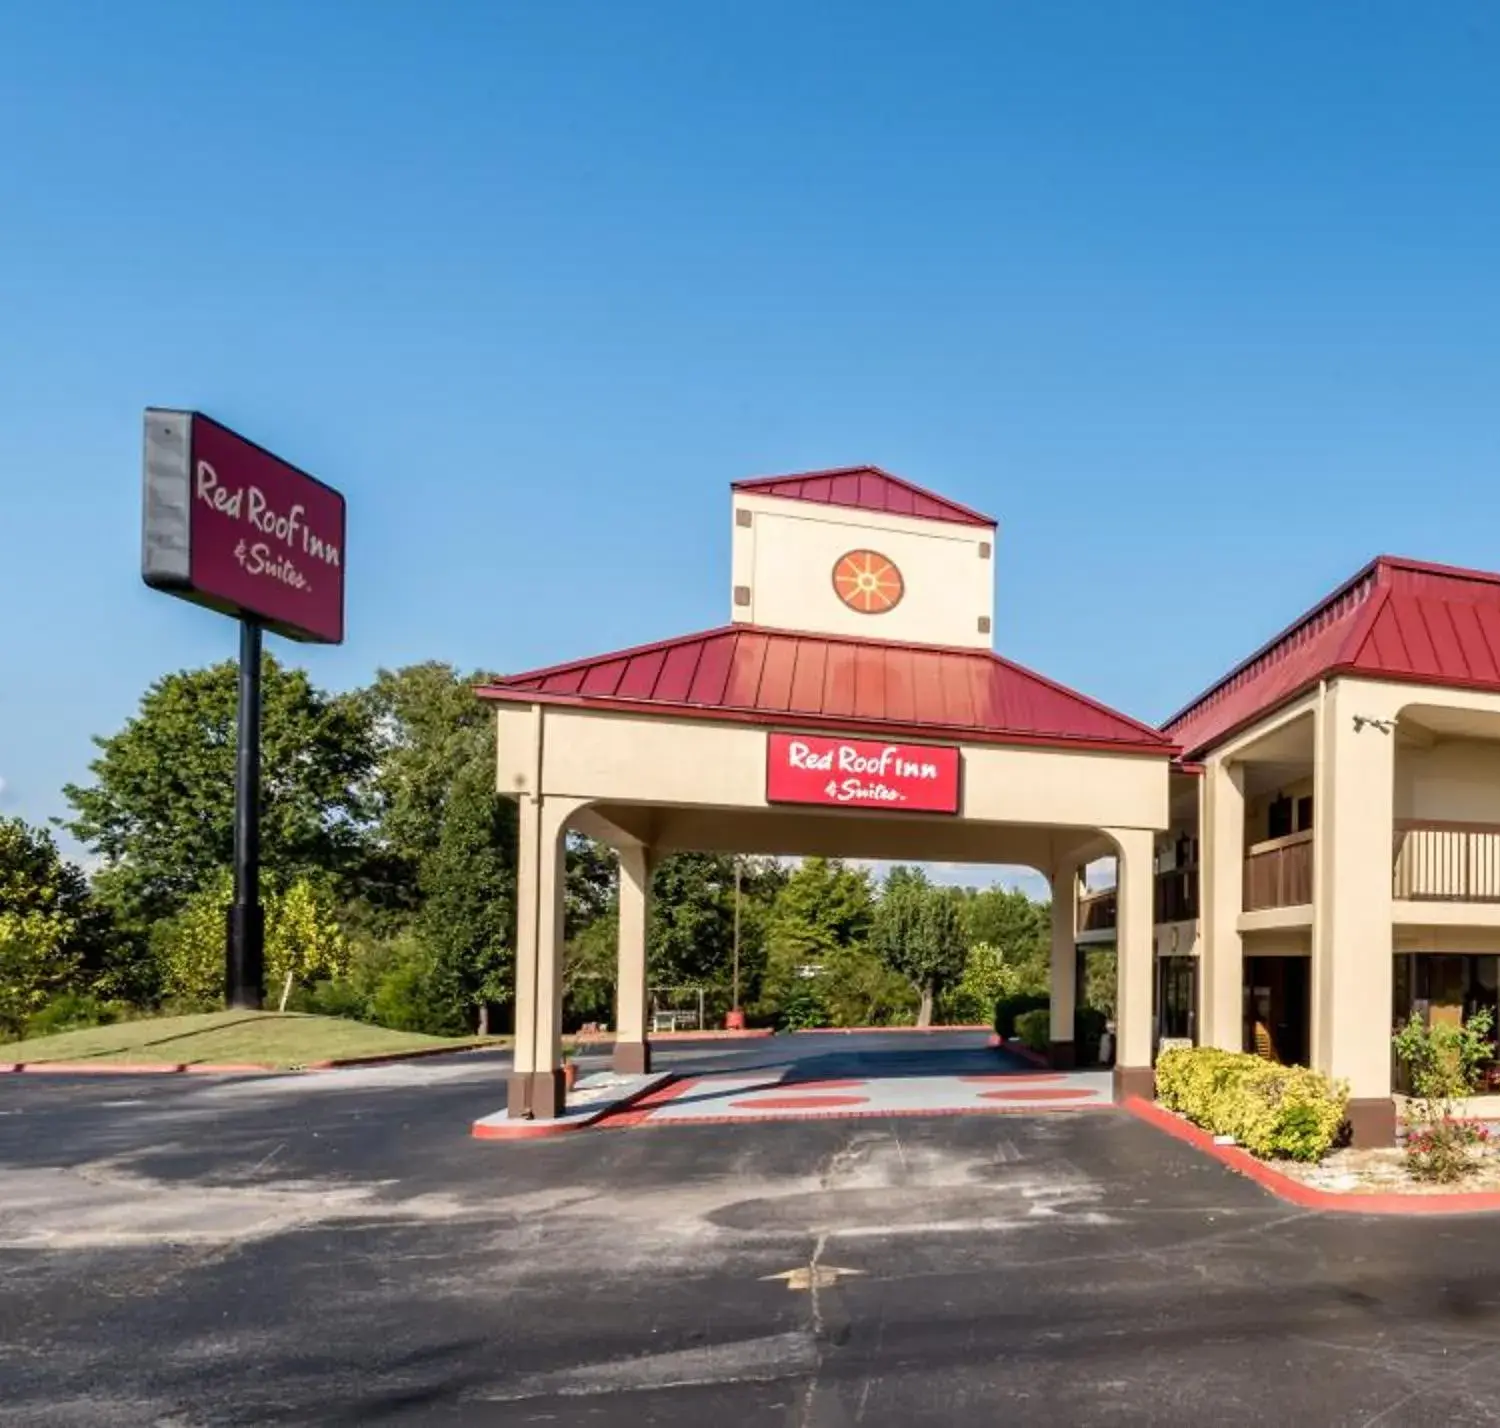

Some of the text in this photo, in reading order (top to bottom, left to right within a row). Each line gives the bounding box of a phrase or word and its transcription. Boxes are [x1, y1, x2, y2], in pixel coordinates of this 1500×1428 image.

[197, 460, 339, 567] Red Roof Inn
[789, 742, 937, 778] Red Roof Inn
